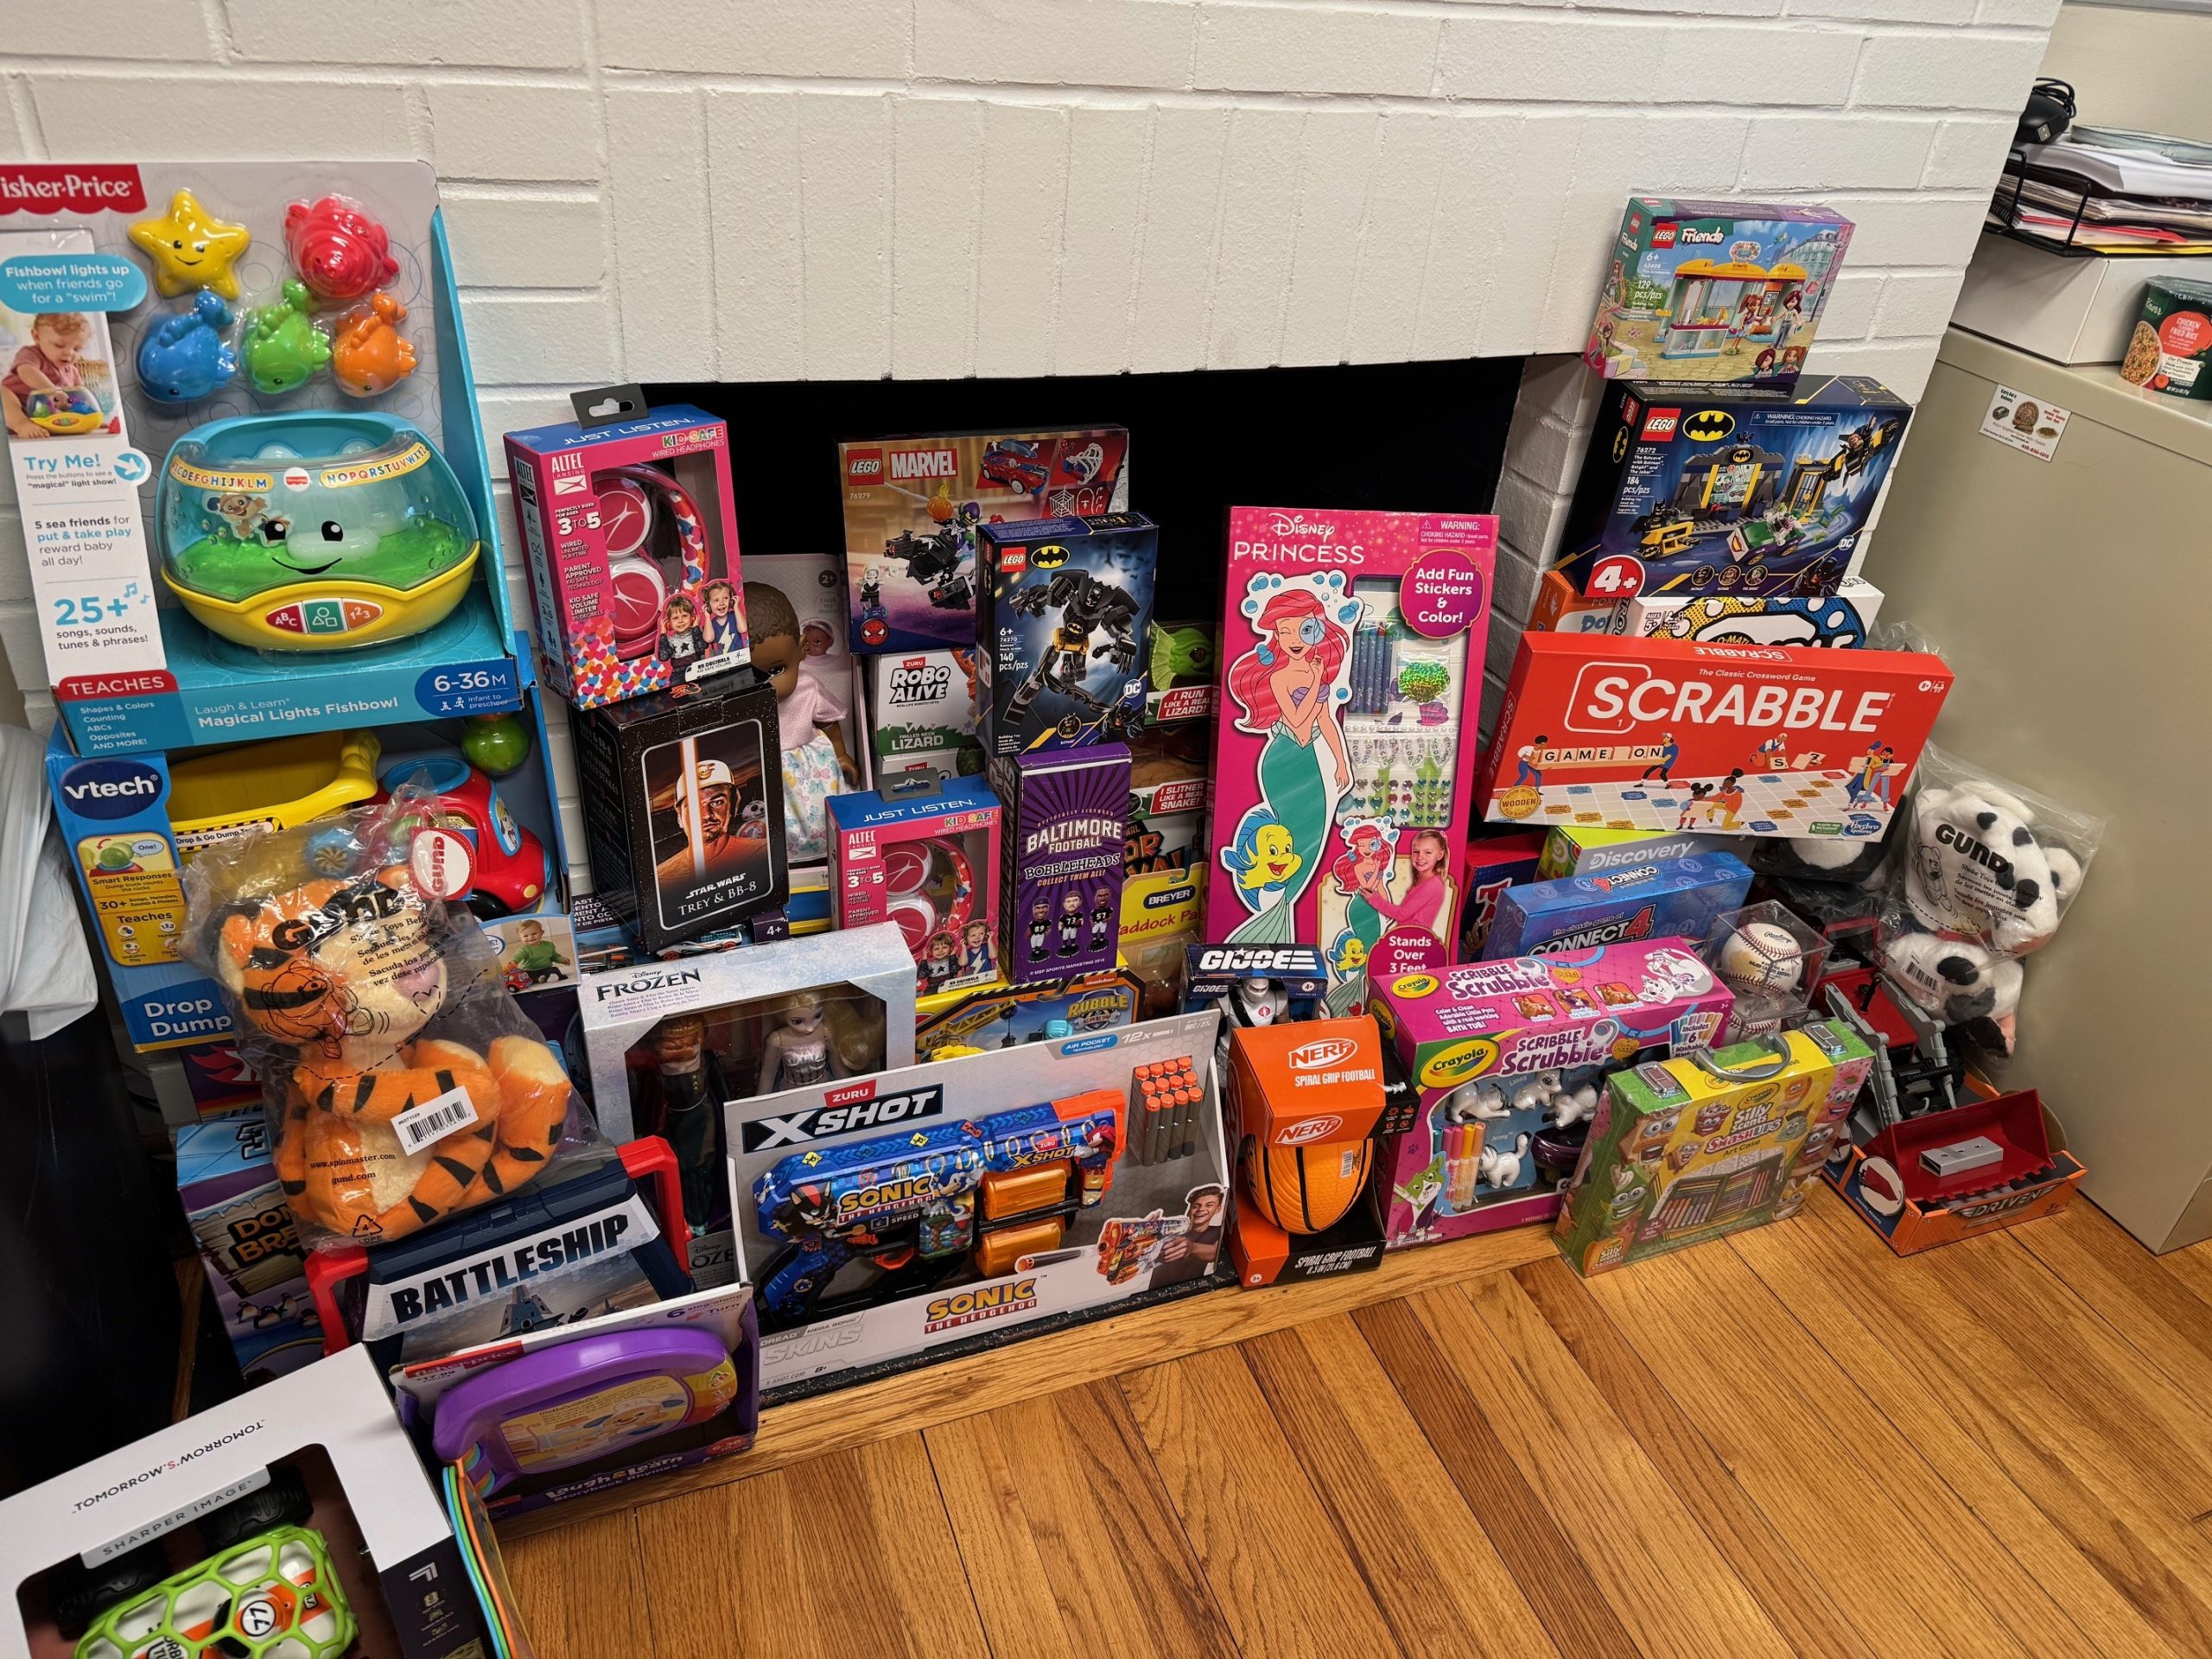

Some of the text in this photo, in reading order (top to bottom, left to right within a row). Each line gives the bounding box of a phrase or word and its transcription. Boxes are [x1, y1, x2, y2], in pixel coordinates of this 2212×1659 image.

[1655, 226, 1724, 244] LEGO Friends
[5, 262, 130, 277] Fishbowl lights up
[16, 277, 124, 291] when friends go
[1634, 290, 1662, 301] pcs/pzs
[2145, 297, 2163, 316] Knorr
[564, 417, 696, 446] JUST LISTEN.
[1646, 418, 1677, 431] LEGO
[652, 439, 725, 458] WIRED HEADPHONES
[23, 453, 102, 473] Try Me!
[551, 452, 585, 474] ALTEC
[849, 450, 957, 480] LEGO MARVEL
[1623, 484, 1651, 495] pcs/pzs
[1626, 476, 1640, 485] 184
[35, 516, 130, 530] 5 sea friends for
[1268, 513, 1336, 543] Disney
[1440, 520, 1480, 531] WARNING:
[36, 527, 132, 543] put & take play
[560, 539, 583, 549] WIRED
[39, 541, 113, 555] reward baby
[1233, 540, 1365, 564] PRINCESS
[41, 555, 83, 567] all day!
[564, 563, 591, 573] PARENT
[1003, 554, 1027, 565] LEGO
[565, 567, 602, 580] APPROVED
[1414, 568, 1474, 582] Add Fun
[1593, 565, 1638, 593] 4+
[1414, 582, 1473, 594] Stickers
[54, 596, 129, 626] 25+
[1417, 609, 1463, 623] Color!
[56, 624, 137, 639] songs, sounds,
[58, 634, 149, 650] tunes & phrases!
[999, 652, 1014, 662] 140
[1694, 646, 1785, 660] SCRABBLE
[999, 659, 1028, 672] pcs/pzs
[67, 676, 165, 695] TEACHES
[434, 671, 507, 692] 6-36 M
[891, 666, 950, 688] ROBO
[1715, 669, 1745, 678] Classic
[1746, 671, 1791, 681] Crossword
[1792, 674, 1816, 683] Game
[891, 683, 947, 704] ALIVE
[194, 697, 287, 716] Laugh & Learn
[199, 696, 399, 728] Magical Lights Fishbowl
[1165, 704, 1207, 717] LIZARD!
[1586, 677, 1891, 734] SCRABBLE
[83, 713, 126, 724] Counting
[86, 724, 112, 733] ABCs
[89, 730, 137, 743] Opposites
[92, 738, 148, 751] AND MORE!
[891, 734, 944, 751] LIZARD
[64, 775, 156, 800] vtech
[1166, 783, 1205, 794] SLITHER
[863, 798, 977, 823] JUST LISTEN.
[1160, 798, 1200, 810] SNAKE!
[1501, 798, 1537, 808] WOODEN
[848, 830, 876, 846] ALTEC
[1026, 818, 1123, 855] BALTIMORE
[1047, 836, 1103, 855] FOOTBALL
[1588, 840, 1695, 872] Discovery
[1935, 823, 2010, 874] GUND
[1024, 853, 1122, 880] BOBBLEHEADS
[92, 871, 173, 887] Smart Responses
[685, 872, 747, 899] STAR WARS
[1036, 868, 1107, 887] COLLECT THEM ALL!
[99, 900, 128, 911] 30+
[677, 880, 757, 917] TREY & BB-8
[1147, 889, 1192, 906] BREYER
[116, 911, 173, 925] Teaches
[1624, 905, 1655, 940] 4
[1389, 935, 1432, 948] Stands
[1393, 949, 1425, 962] Over
[1389, 961, 1427, 974] 3 Feet
[1451, 965, 1511, 982] SCRIBBLE
[596, 968, 702, 1002] FROZEN
[1397, 977, 1430, 991] Crayola
[1447, 971, 1550, 999] Scrubbie
[143, 997, 213, 1018] Drop
[1067, 995, 1128, 1020] RUBBLE
[149, 1014, 232, 1039] Dump
[1681, 1020, 1711, 1033] Includes
[1517, 1030, 1581, 1052] SCRIBBLE
[1290, 1041, 1357, 1069] NERF
[1432, 1046, 1486, 1074] Crayola
[1501, 1041, 1605, 1075] Scrubbie
[1294, 1068, 1376, 1088] SPIRAL GRIP FOOTBALL
[832, 1088, 869, 1103] ZURU
[1735, 1102, 1771, 1122] Silly
[1277, 1116, 1344, 1143] NERF
[309, 1151, 397, 1170] www.spinmaster.com
[331, 1171, 376, 1185] gund.com
[839, 1176, 933, 1214] SONIC
[1972, 1187, 2043, 1217] DRIVEN
[890, 1211, 919, 1224] SPEED
[1294, 1246, 1377, 1269] SPIRAL GRIP FOOTBALL
[390, 1212, 630, 1325] BATTLESHIP
[925, 1278, 1038, 1323] SONIC
[926, 1300, 1037, 1332] THE HEDGEHOG
[760, 1315, 857, 1346] DREAD MEGA SONIC
[762, 1325, 862, 1366] SKINS
[102, 1482, 250, 1556] SHARPER IMAGE
